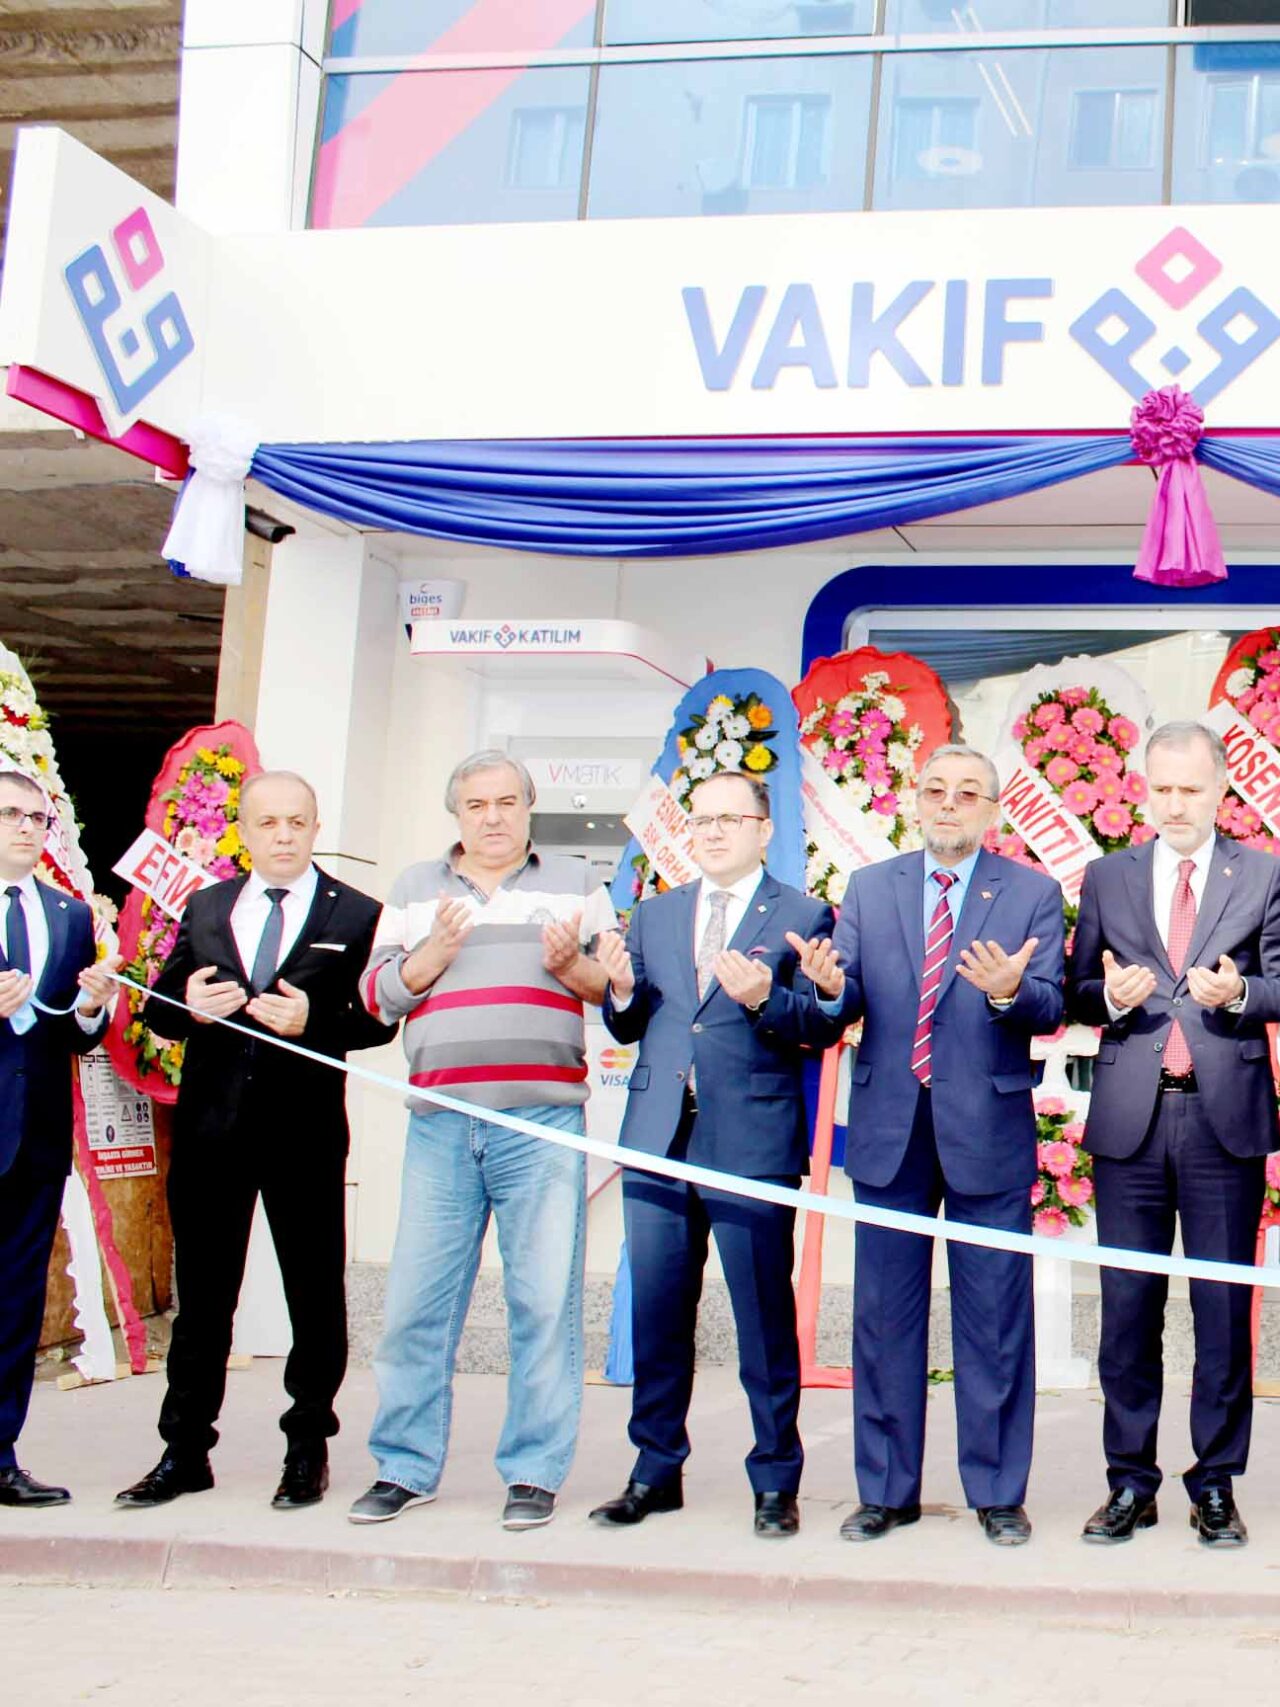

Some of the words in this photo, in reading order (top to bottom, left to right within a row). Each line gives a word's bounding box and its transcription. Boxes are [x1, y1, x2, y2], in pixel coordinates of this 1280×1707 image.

[680, 276, 1056, 390] VAKIF
[409, 593, 442, 606] biges
[449, 629, 492, 643] VAKIF
[518, 629, 581, 643] KATILIM
